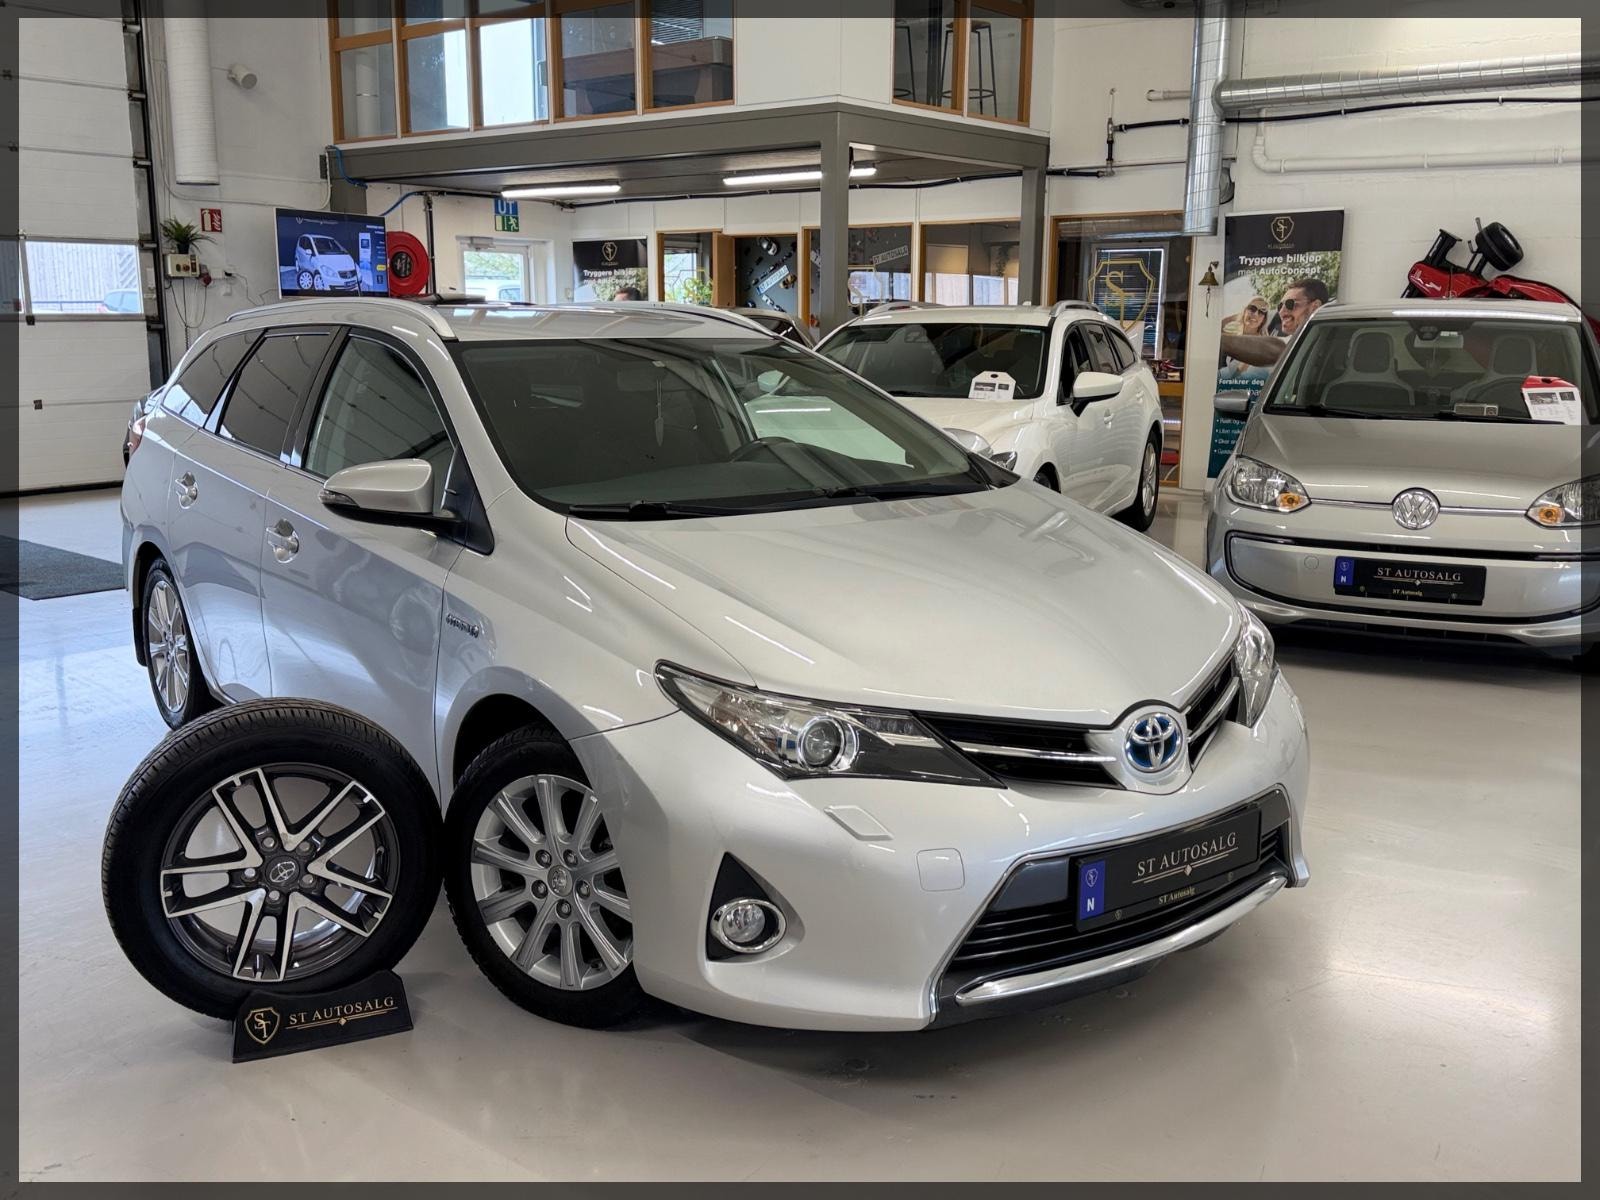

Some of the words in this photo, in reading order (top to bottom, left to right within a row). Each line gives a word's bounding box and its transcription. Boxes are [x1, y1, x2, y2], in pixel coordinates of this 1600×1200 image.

[497, 199, 515, 215] UT
[1238, 255, 1283, 266] Tryggere
[1286, 253, 1322, 264] bilkjøp
[583, 269, 613, 278] Tryggere
[1259, 266, 1321, 276] AutoConcept
[1251, 379, 1265, 387] deg
[1340, 575, 1347, 584] N
[1377, 567, 1392, 577] ST
[1394, 569, 1462, 582] AUTOSALG
[1137, 858, 1156, 877] ST
[1159, 831, 1237, 870] AUTOSALG
[1158, 895, 1168, 905] ST
[1168, 886, 1196, 902] Autosalg
[1086, 897, 1095, 912] N
[289, 1011, 309, 1025] ST
[312, 996, 395, 1021] AUTOSALG
